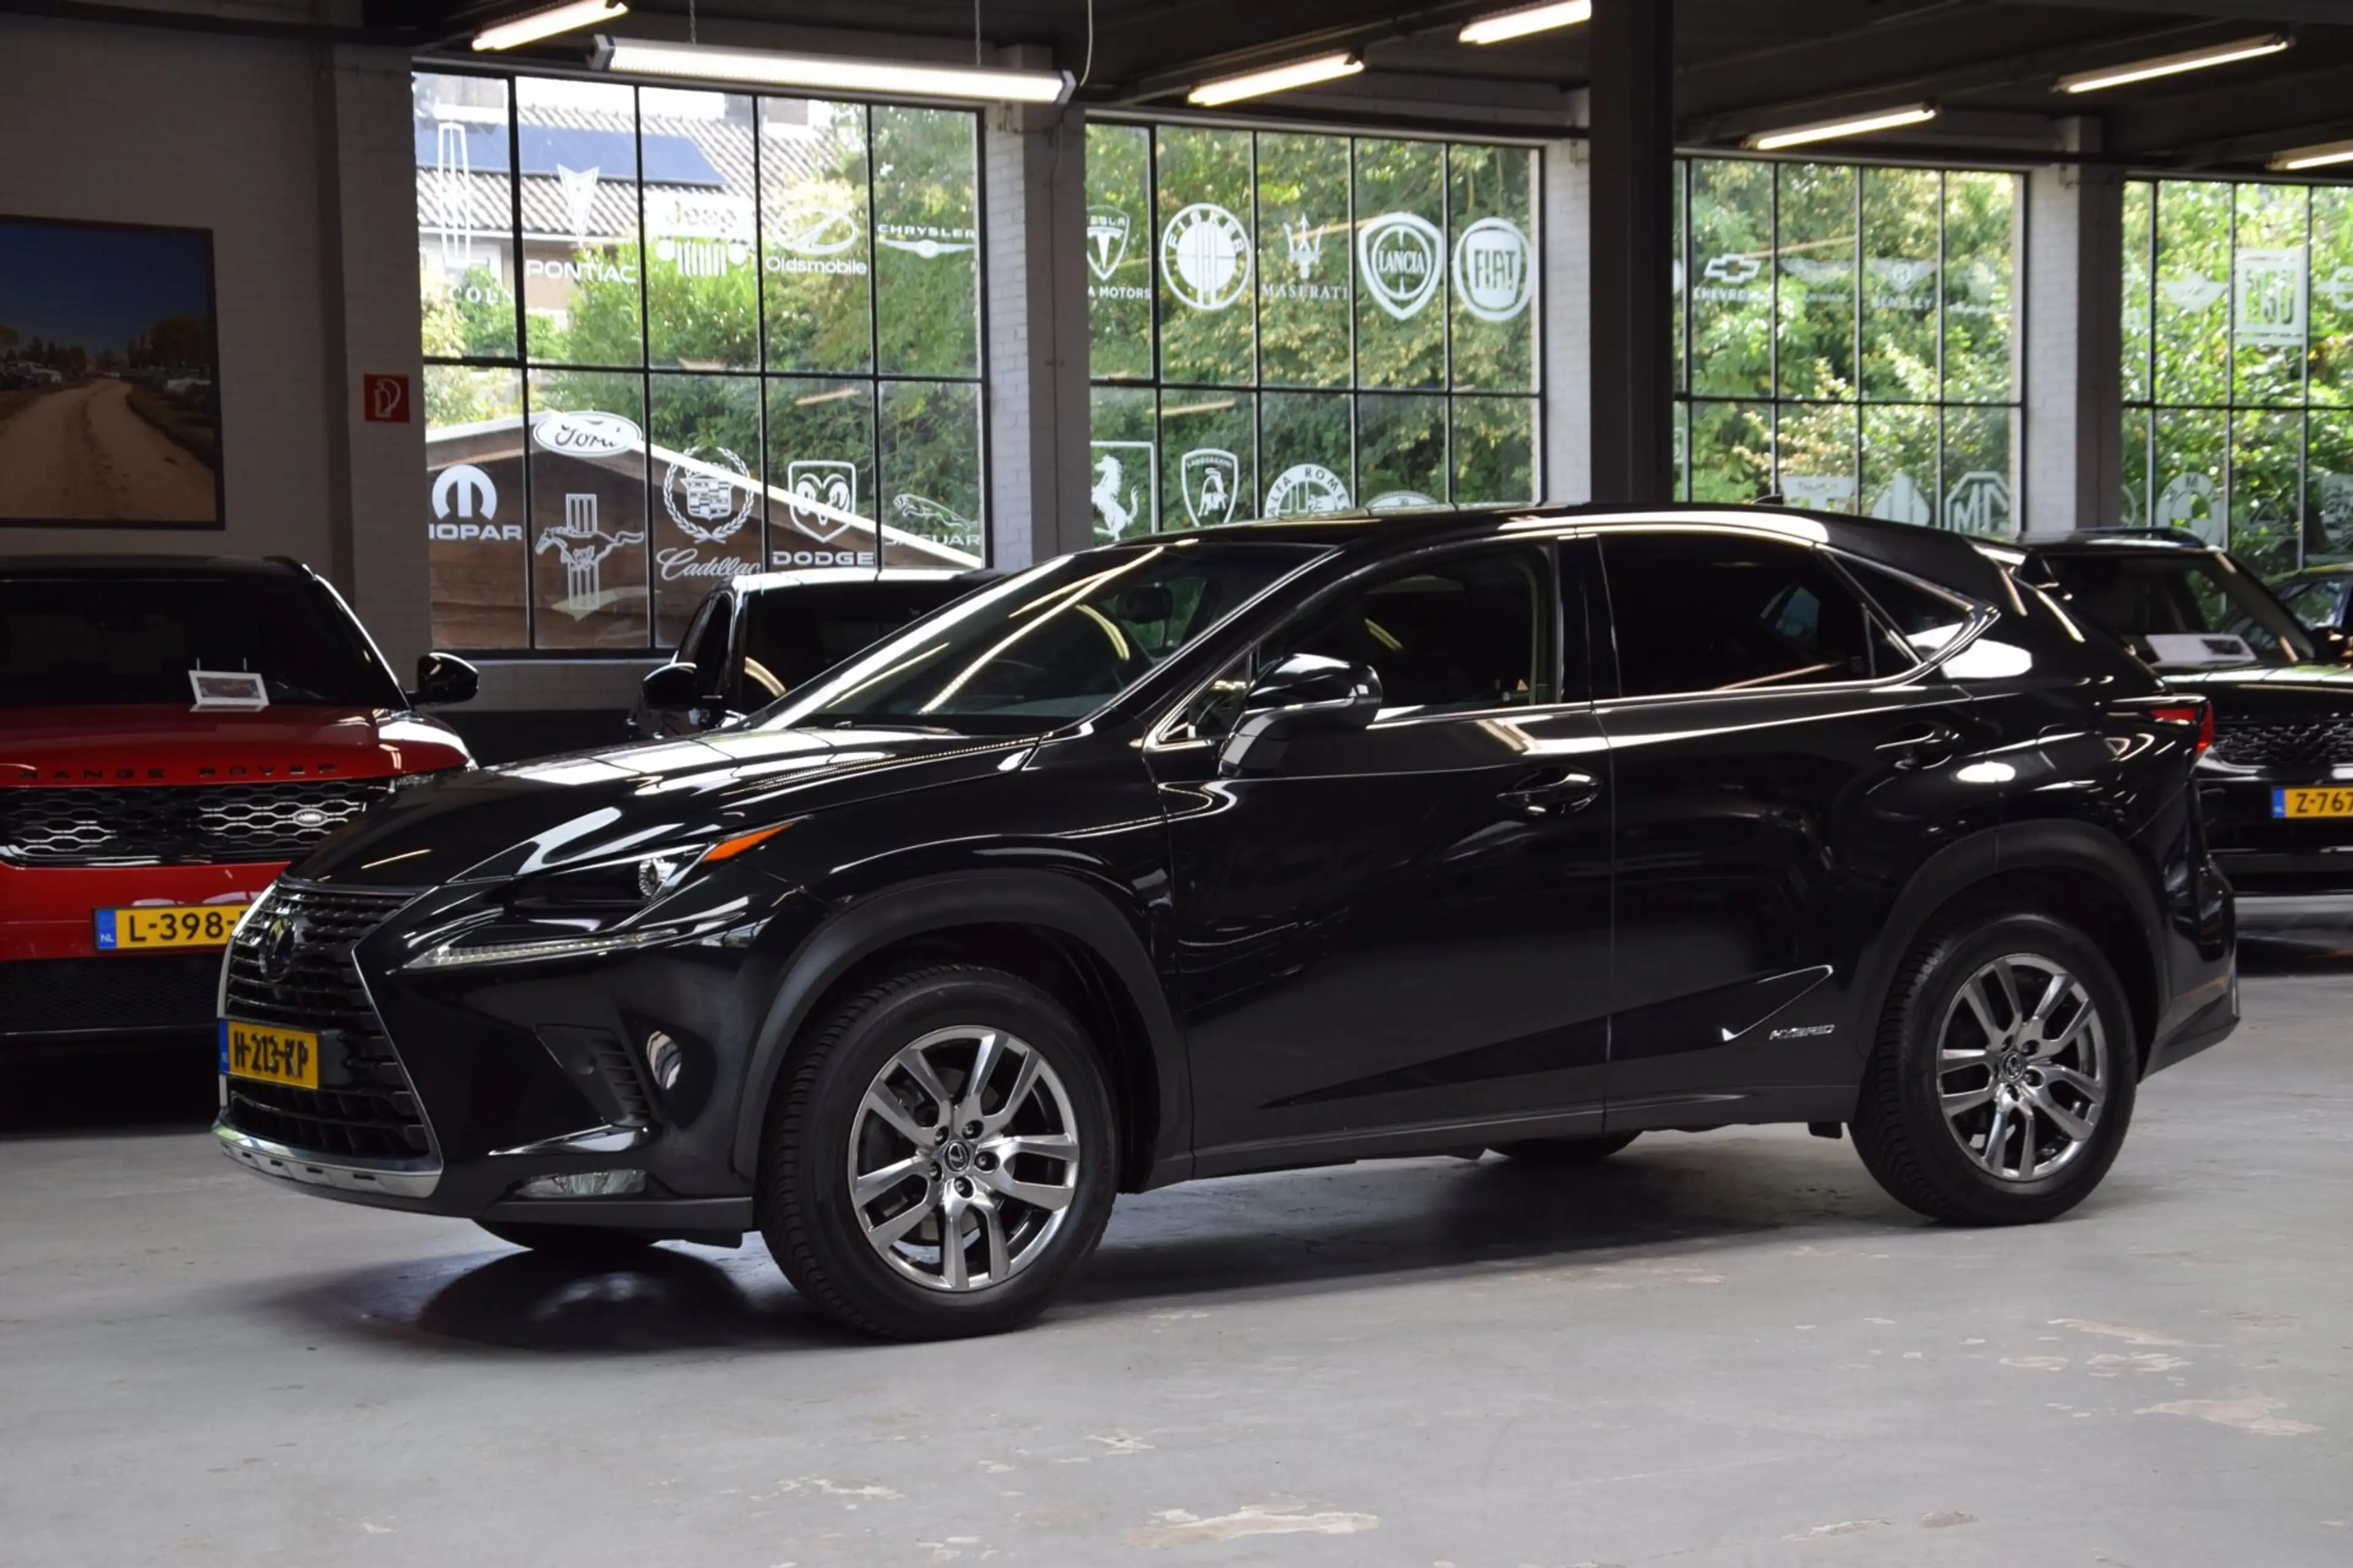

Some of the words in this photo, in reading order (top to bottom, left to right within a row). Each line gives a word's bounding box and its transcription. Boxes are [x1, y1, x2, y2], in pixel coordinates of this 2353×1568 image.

[877, 224, 976, 238] CHRYSLER
[765, 256, 867, 275] Oldsmobile
[1378, 250, 1425, 274] LANCIA
[1473, 249, 1517, 290] FIAT
[525, 260, 637, 284] PONTIAC
[1099, 286, 1151, 299] MOTORS
[1262, 282, 1348, 300] MASERATI
[1267, 475, 1292, 516] ALFA
[429, 523, 523, 540] OPAR
[656, 548, 762, 581] Cadillac
[772, 551, 874, 566] DODGE
[129, 911, 249, 942] L-398-
[100, 934, 115, 943] NL
